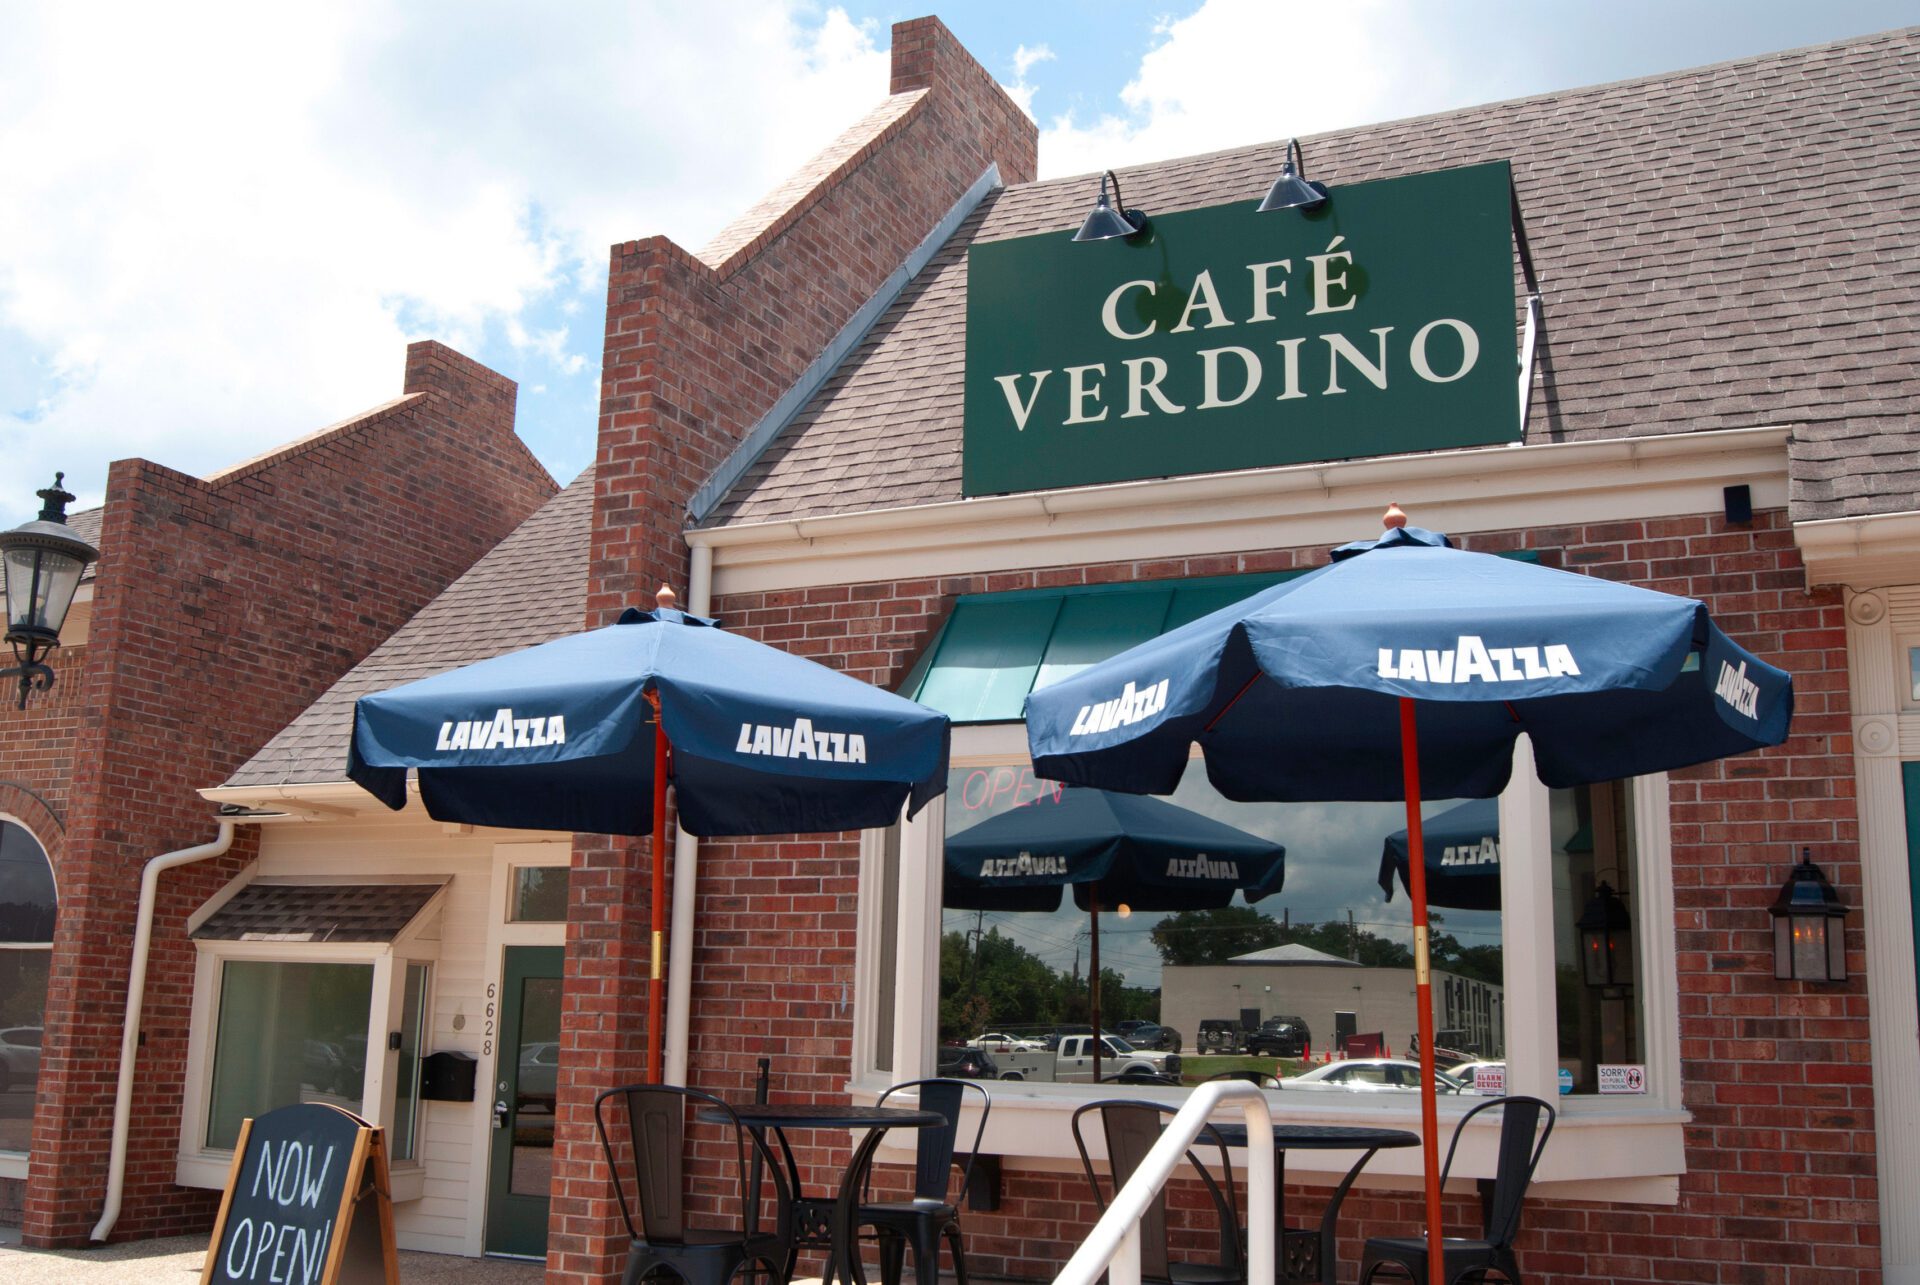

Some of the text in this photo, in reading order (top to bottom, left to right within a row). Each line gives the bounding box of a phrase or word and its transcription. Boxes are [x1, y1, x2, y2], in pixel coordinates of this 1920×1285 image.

[1101, 236, 1357, 341] CAFÉ
[993, 318, 1480, 432] VERDINO
[1377, 636, 1581, 684] LAVAZZA
[435, 708, 566, 751] LAVAZZA
[1069, 679, 1169, 736] LAVAZZA
[735, 717, 867, 764] LAVAZZA
[962, 767, 1065, 810] OPEN
[483, 983, 496, 1055] 6628
[1601, 1068, 1627, 1077] SORRY
[251, 1140, 334, 1209] NOW
